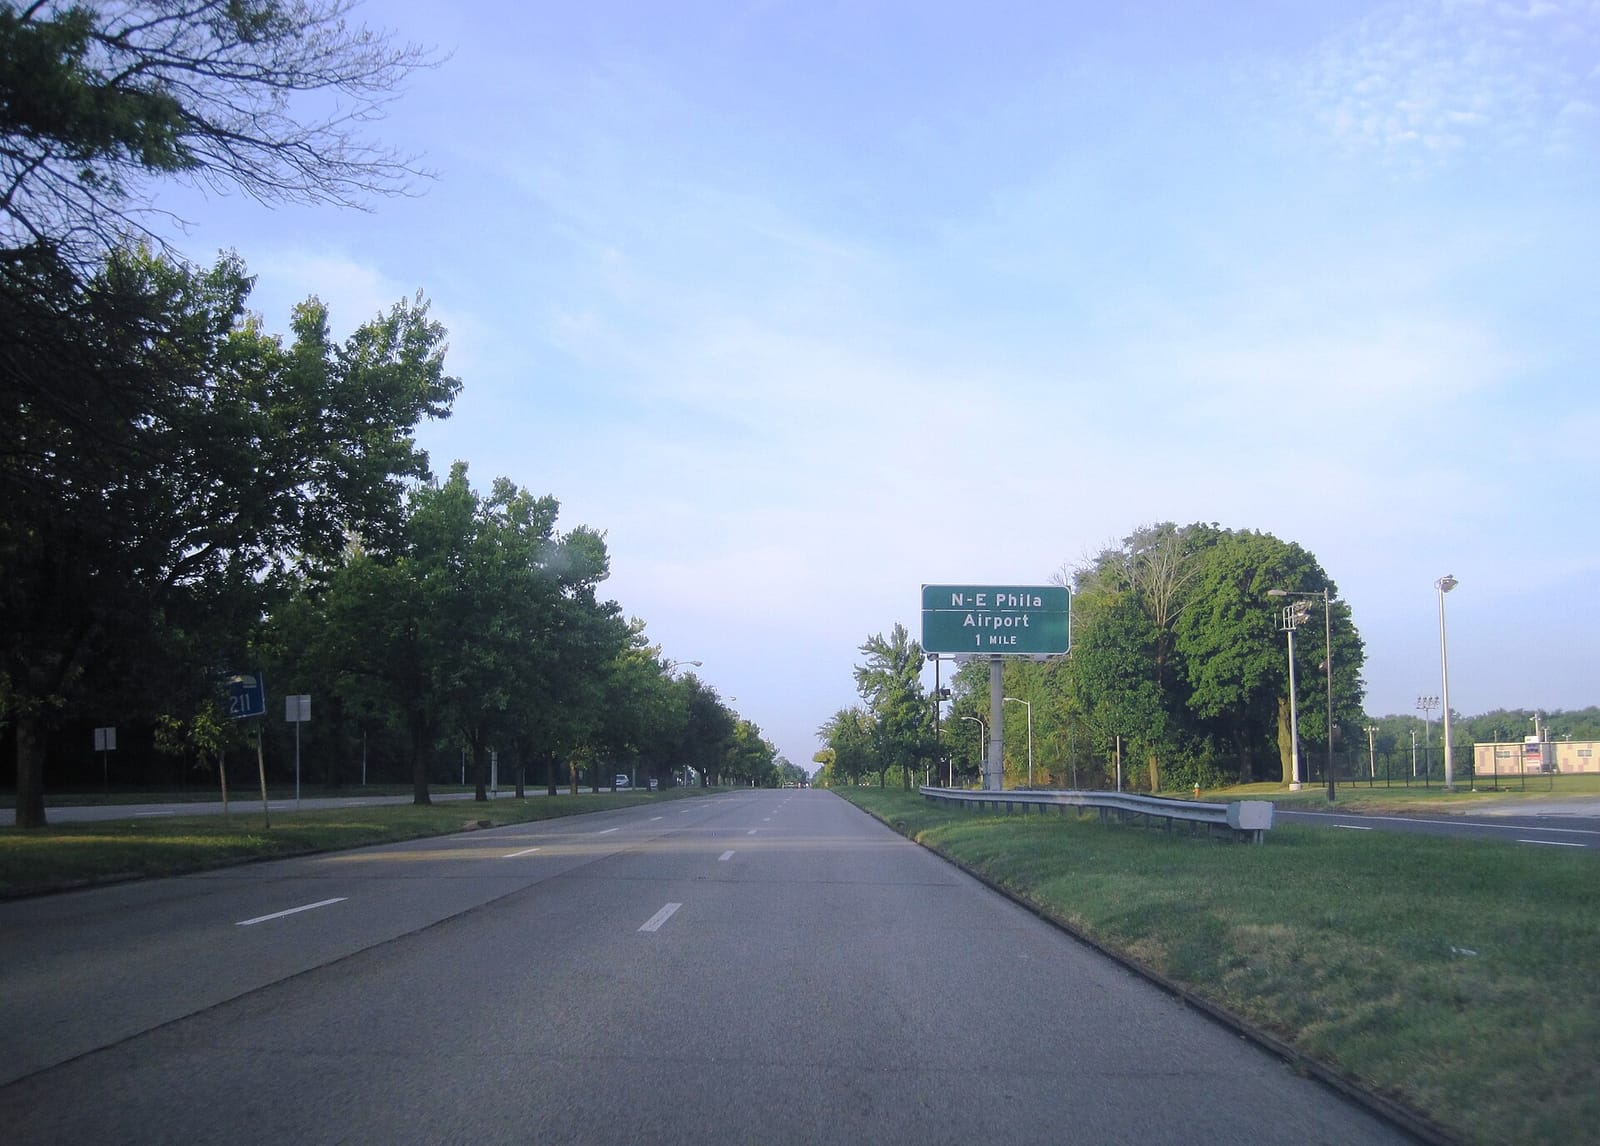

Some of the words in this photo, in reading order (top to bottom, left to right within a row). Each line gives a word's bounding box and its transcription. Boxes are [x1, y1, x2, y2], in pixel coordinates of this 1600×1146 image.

[952, 593, 986, 607] N-E
[996, 593, 1042, 607] Phila
[963, 613, 1029, 629] Airport
[975, 634, 981, 646] 1
[989, 635, 1017, 645] MILE
[230, 693, 250, 714] 211
